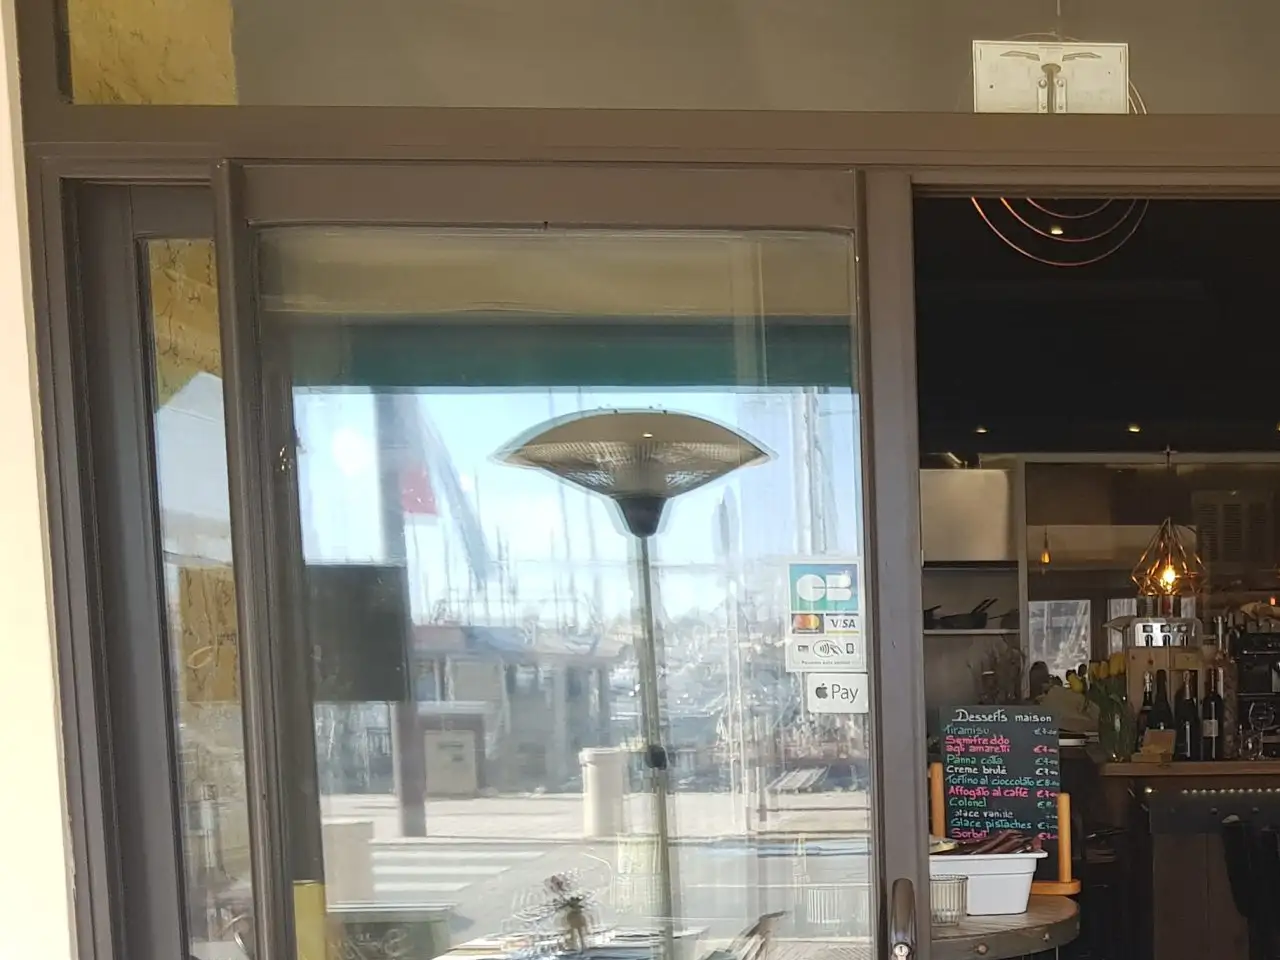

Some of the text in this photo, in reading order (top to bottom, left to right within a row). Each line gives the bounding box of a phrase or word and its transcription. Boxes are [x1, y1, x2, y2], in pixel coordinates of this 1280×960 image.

[830, 618, 857, 629] VISA
[831, 683, 860, 704] Pay
[952, 708, 1052, 722] Desserts maison
[944, 723, 990, 735] Tiramisu
[945, 744, 966, 756] agli
[968, 744, 1011, 754] amaretti
[946, 754, 976, 765] Panna
[980, 755, 1004, 765] cotta
[945, 773, 979, 785] Tortino
[979, 775, 989, 785] al
[991, 775, 1035, 787] cioccolato
[948, 785, 990, 800] Affogato
[991, 787, 1002, 797] al
[949, 797, 987, 808] Colonel
[951, 817, 982, 828] Glace
[985, 819, 1032, 833] pistaches
[951, 827, 989, 839] Sorbet
